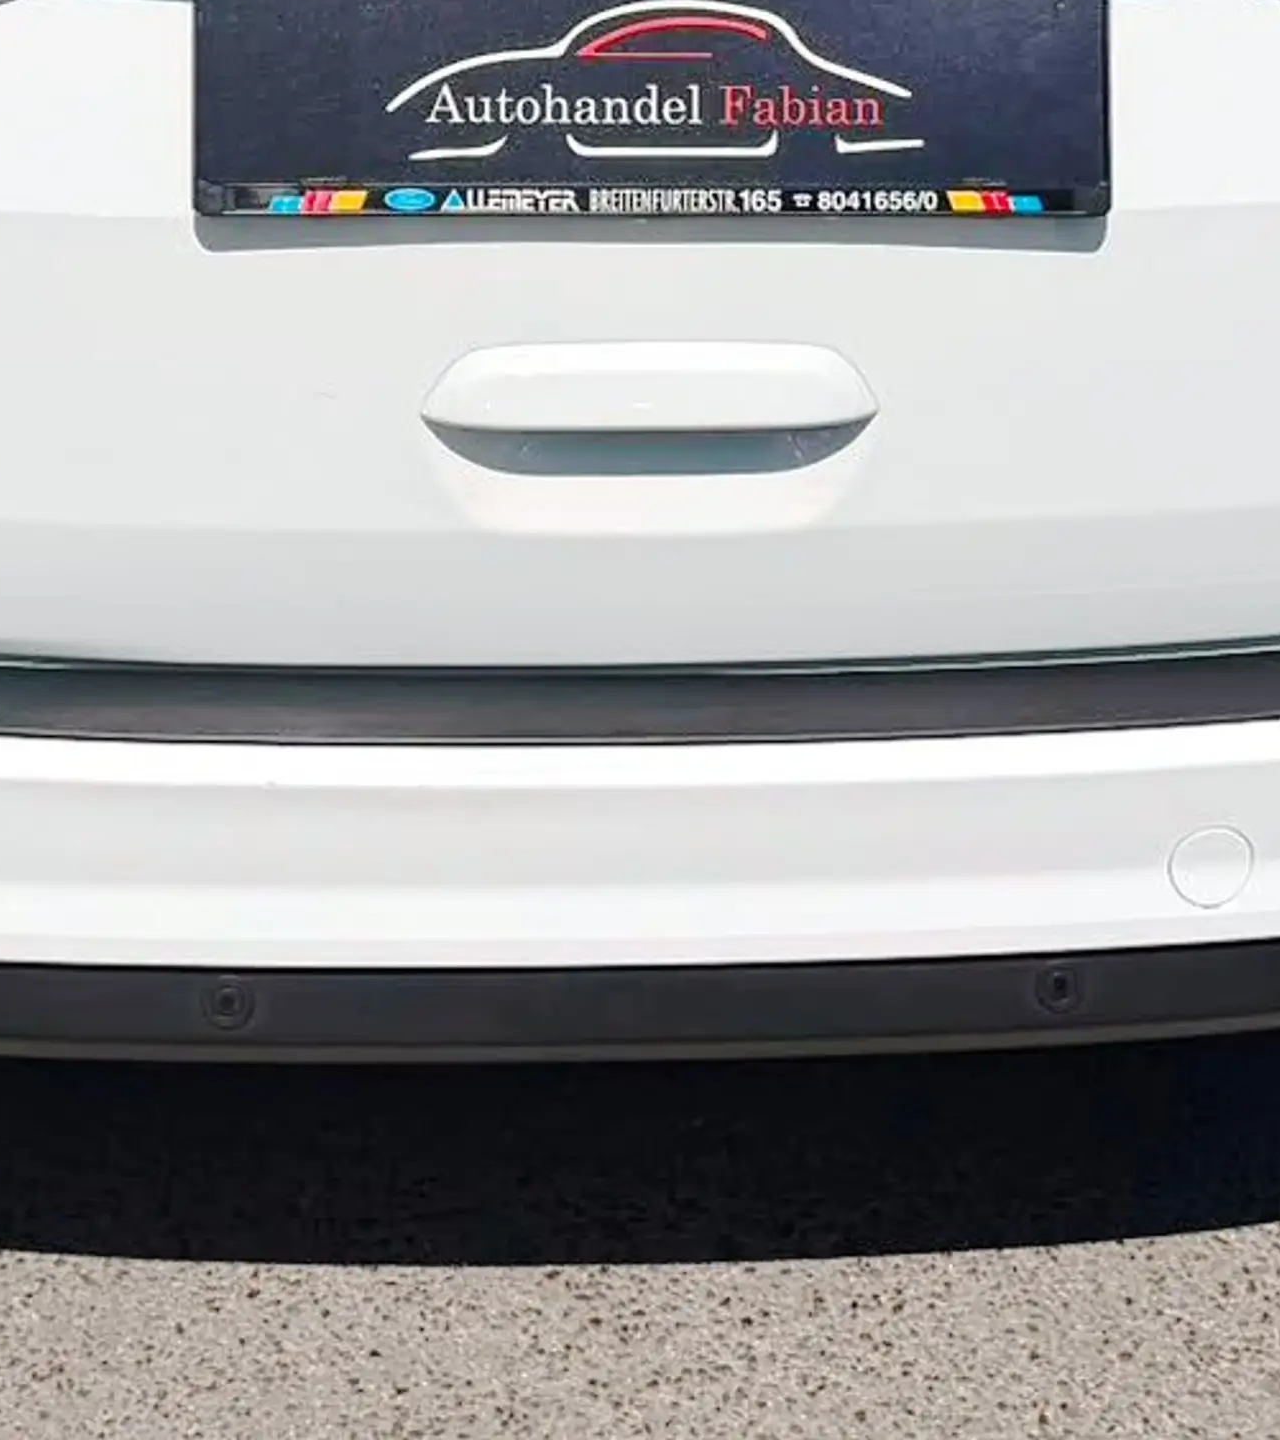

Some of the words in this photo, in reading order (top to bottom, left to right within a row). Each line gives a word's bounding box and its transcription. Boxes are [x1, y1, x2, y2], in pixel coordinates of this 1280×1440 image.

[427, 83, 703, 127] Autohandel
[719, 85, 885, 127] Fabian
[441, 189, 581, 213] ALLEMEYER
[817, 189, 938, 212] 8041656/0
